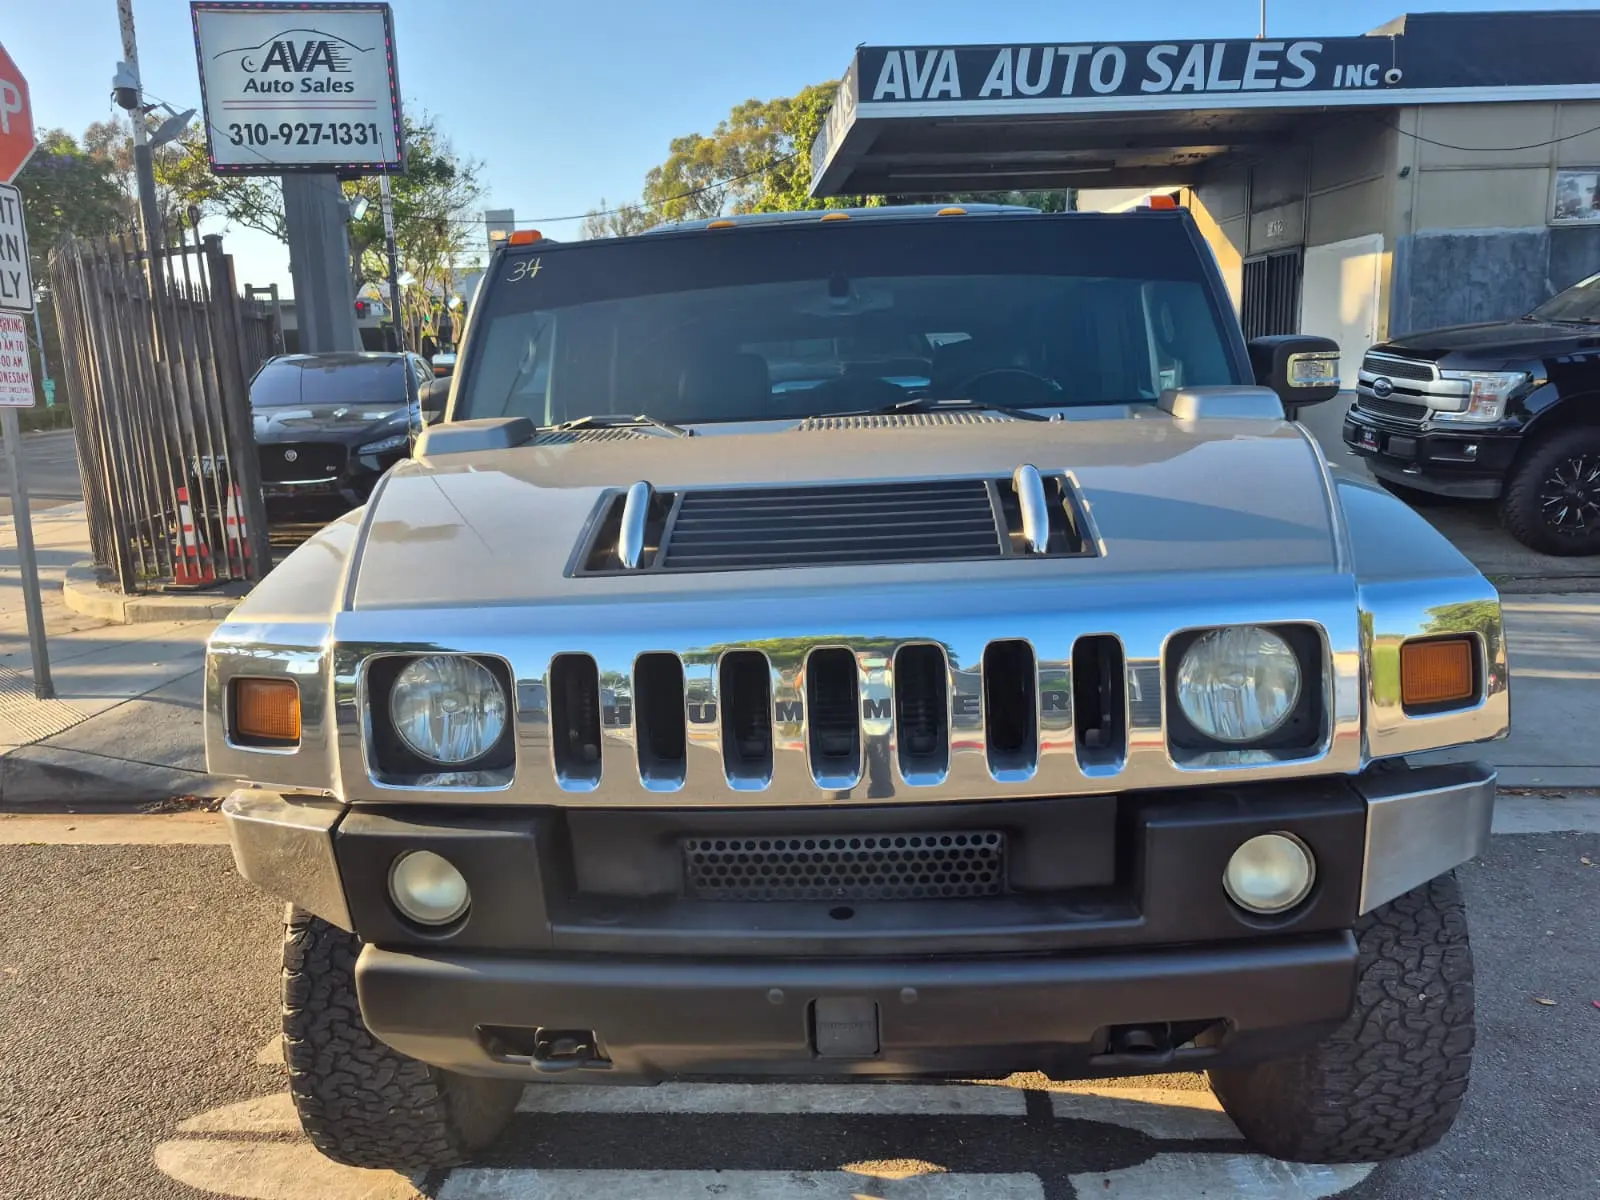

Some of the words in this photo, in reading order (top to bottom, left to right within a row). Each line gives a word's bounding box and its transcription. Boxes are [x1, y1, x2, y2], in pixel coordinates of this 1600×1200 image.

[260, 41, 340, 72] AVA
[873, 50, 961, 100] AVA
[978, 46, 1126, 98] AUTO
[1141, 41, 1323, 93] SALES
[1333, 63, 1379, 88] INC
[243, 78, 294, 93] Auto
[300, 77, 354, 93] Sales
[229, 122, 379, 146] 310-927-1331
[506, 257, 543, 282] 34
[603, 691, 1070, 725] HUMMER
